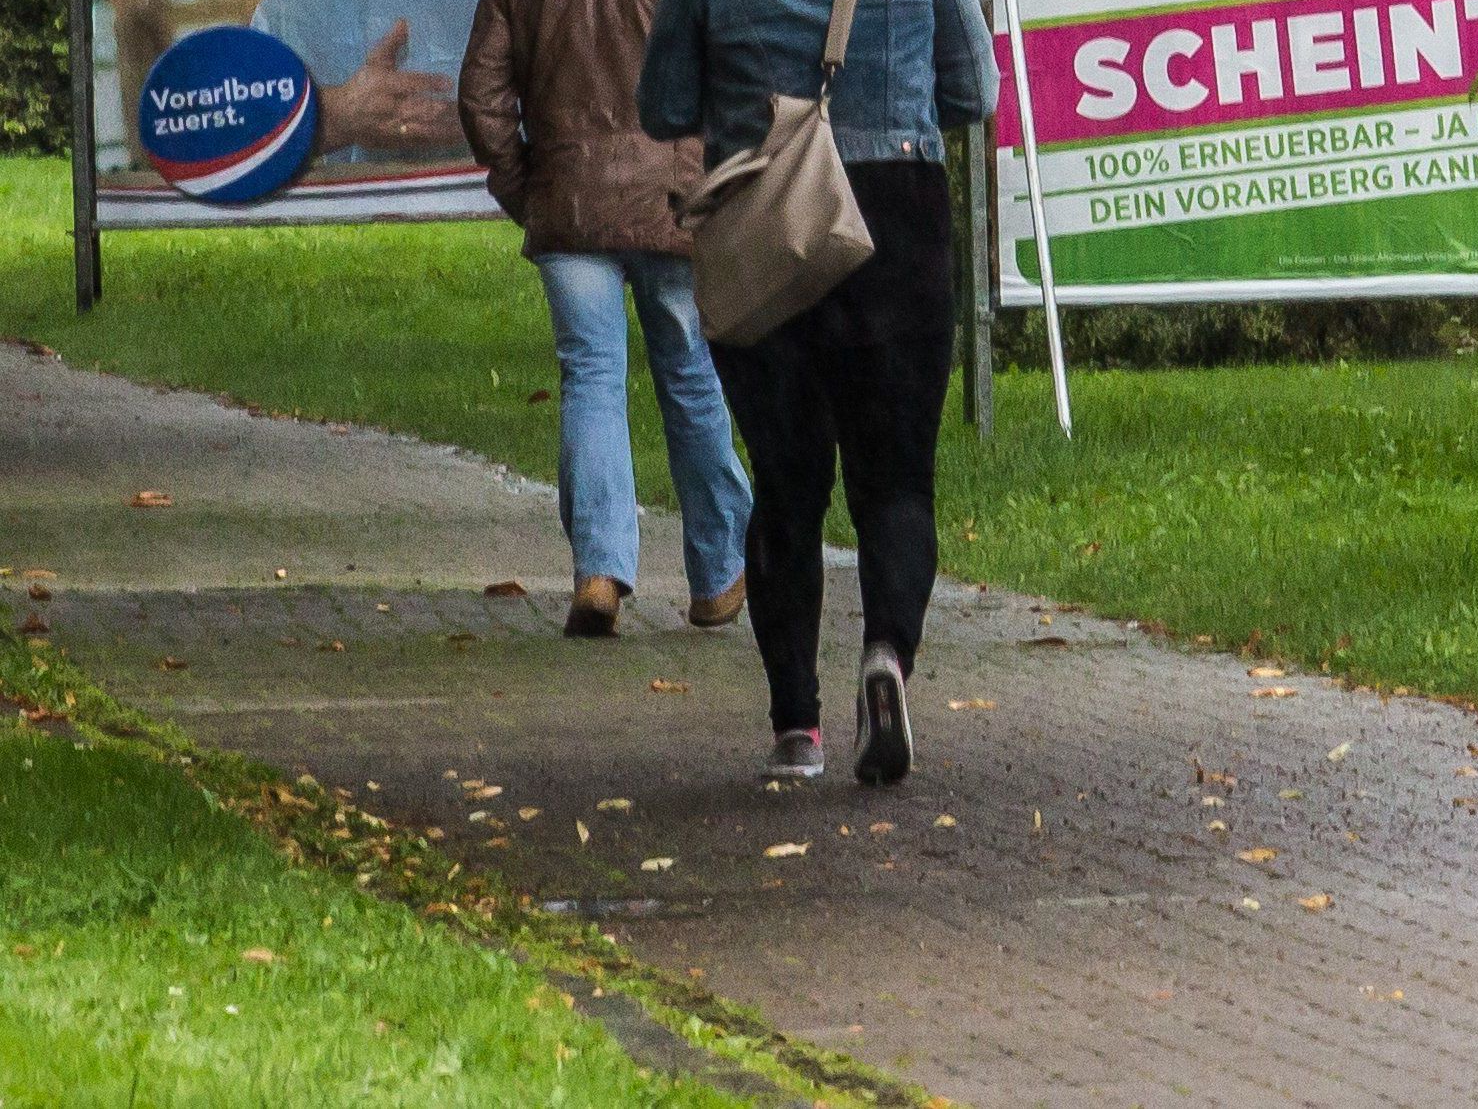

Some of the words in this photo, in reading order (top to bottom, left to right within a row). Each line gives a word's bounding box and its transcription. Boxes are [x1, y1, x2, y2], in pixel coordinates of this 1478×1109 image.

[149, 76, 295, 112] Vorarlberg
[154, 104, 245, 136] zuerst.
[1084, 144, 1170, 182] 100%
[1178, 120, 1395, 171] ERNEUERBAR
[1431, 109, 1469, 140] JA
[1089, 192, 1167, 225] DEIN
[1175, 164, 1394, 214] VORARLBERG
